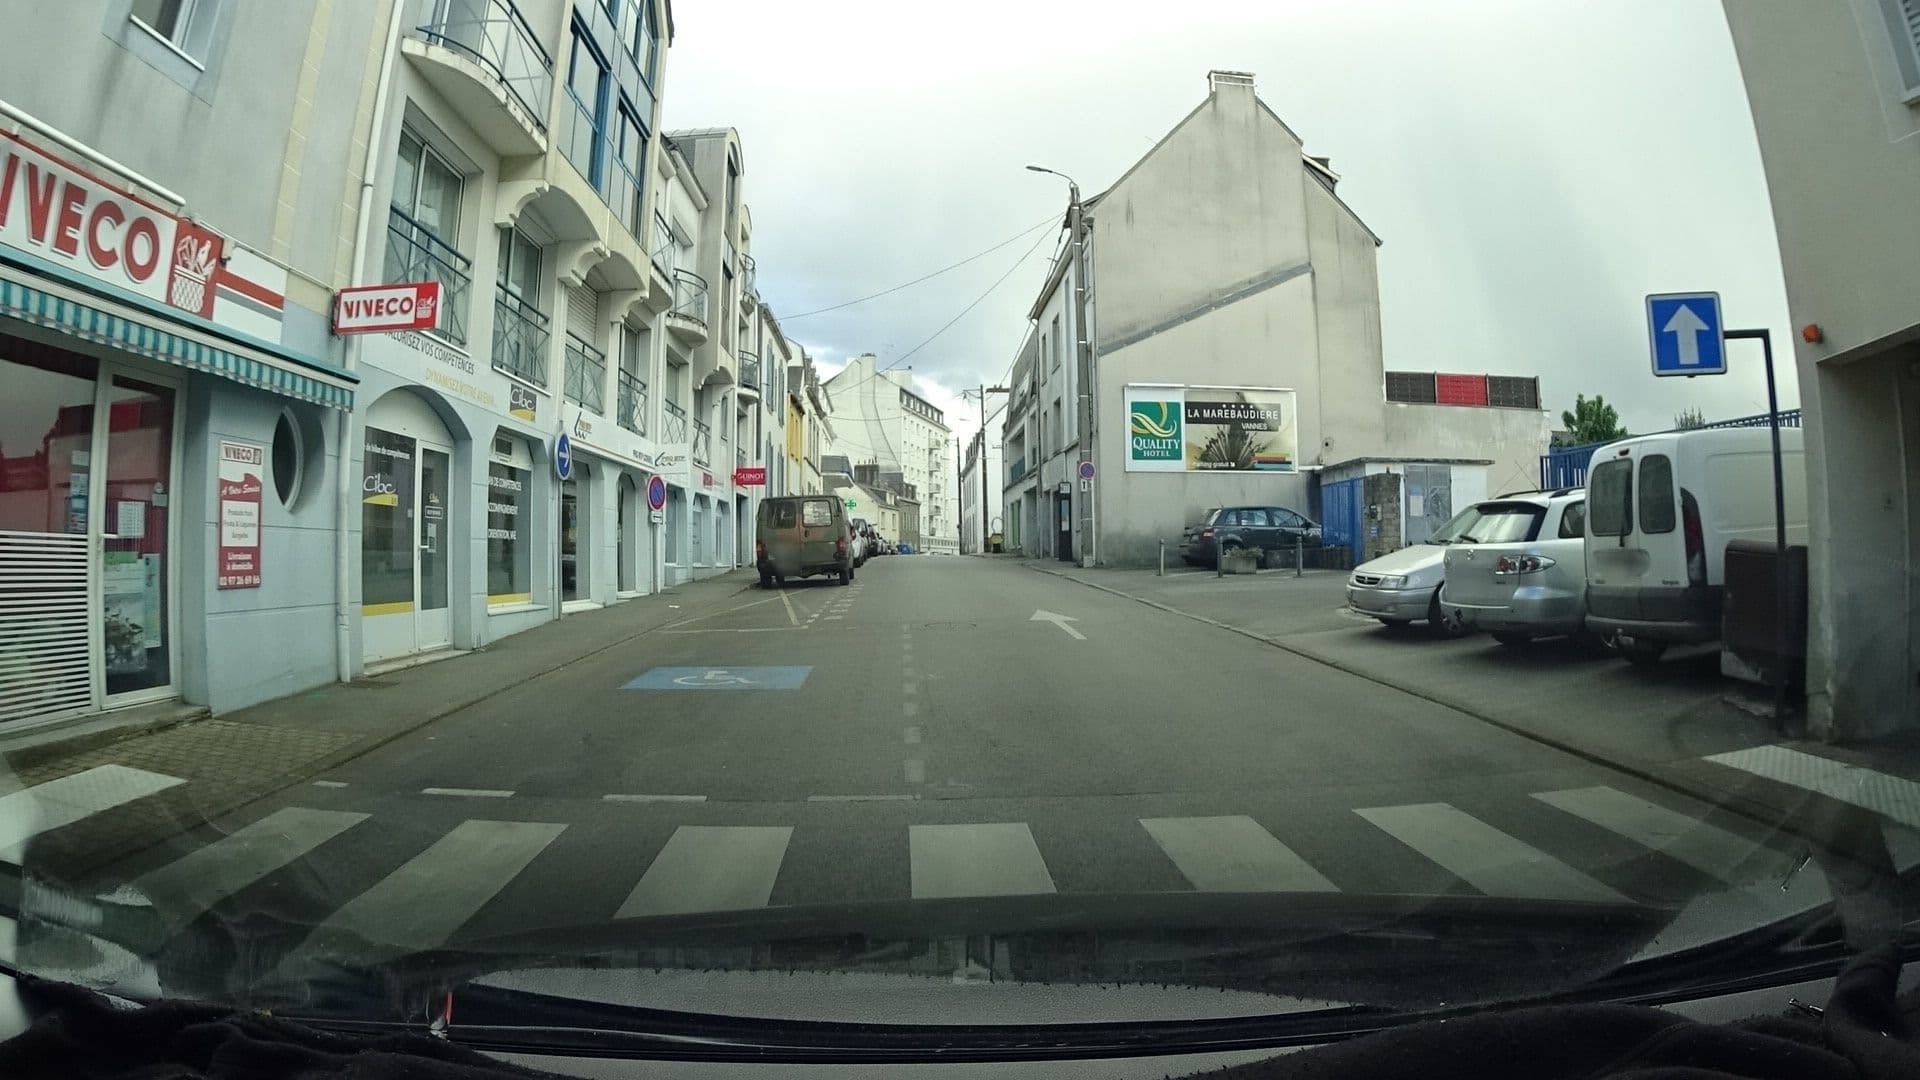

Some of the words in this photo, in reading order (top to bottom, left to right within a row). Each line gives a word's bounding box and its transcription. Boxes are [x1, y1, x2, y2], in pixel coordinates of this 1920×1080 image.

[0, 152, 160, 283] IVECO
[344, 297, 414, 318] VIVECO
[421, 341, 434, 356] VOS
[511, 386, 535, 410] Cibc
[1187, 409, 1200, 418] LA
[1203, 409, 1279, 420] MAREBAUDIERE
[1132, 437, 1181, 450] QUALITY
[223, 446, 252, 460] VIVECO
[363, 472, 396, 494] Cibc
